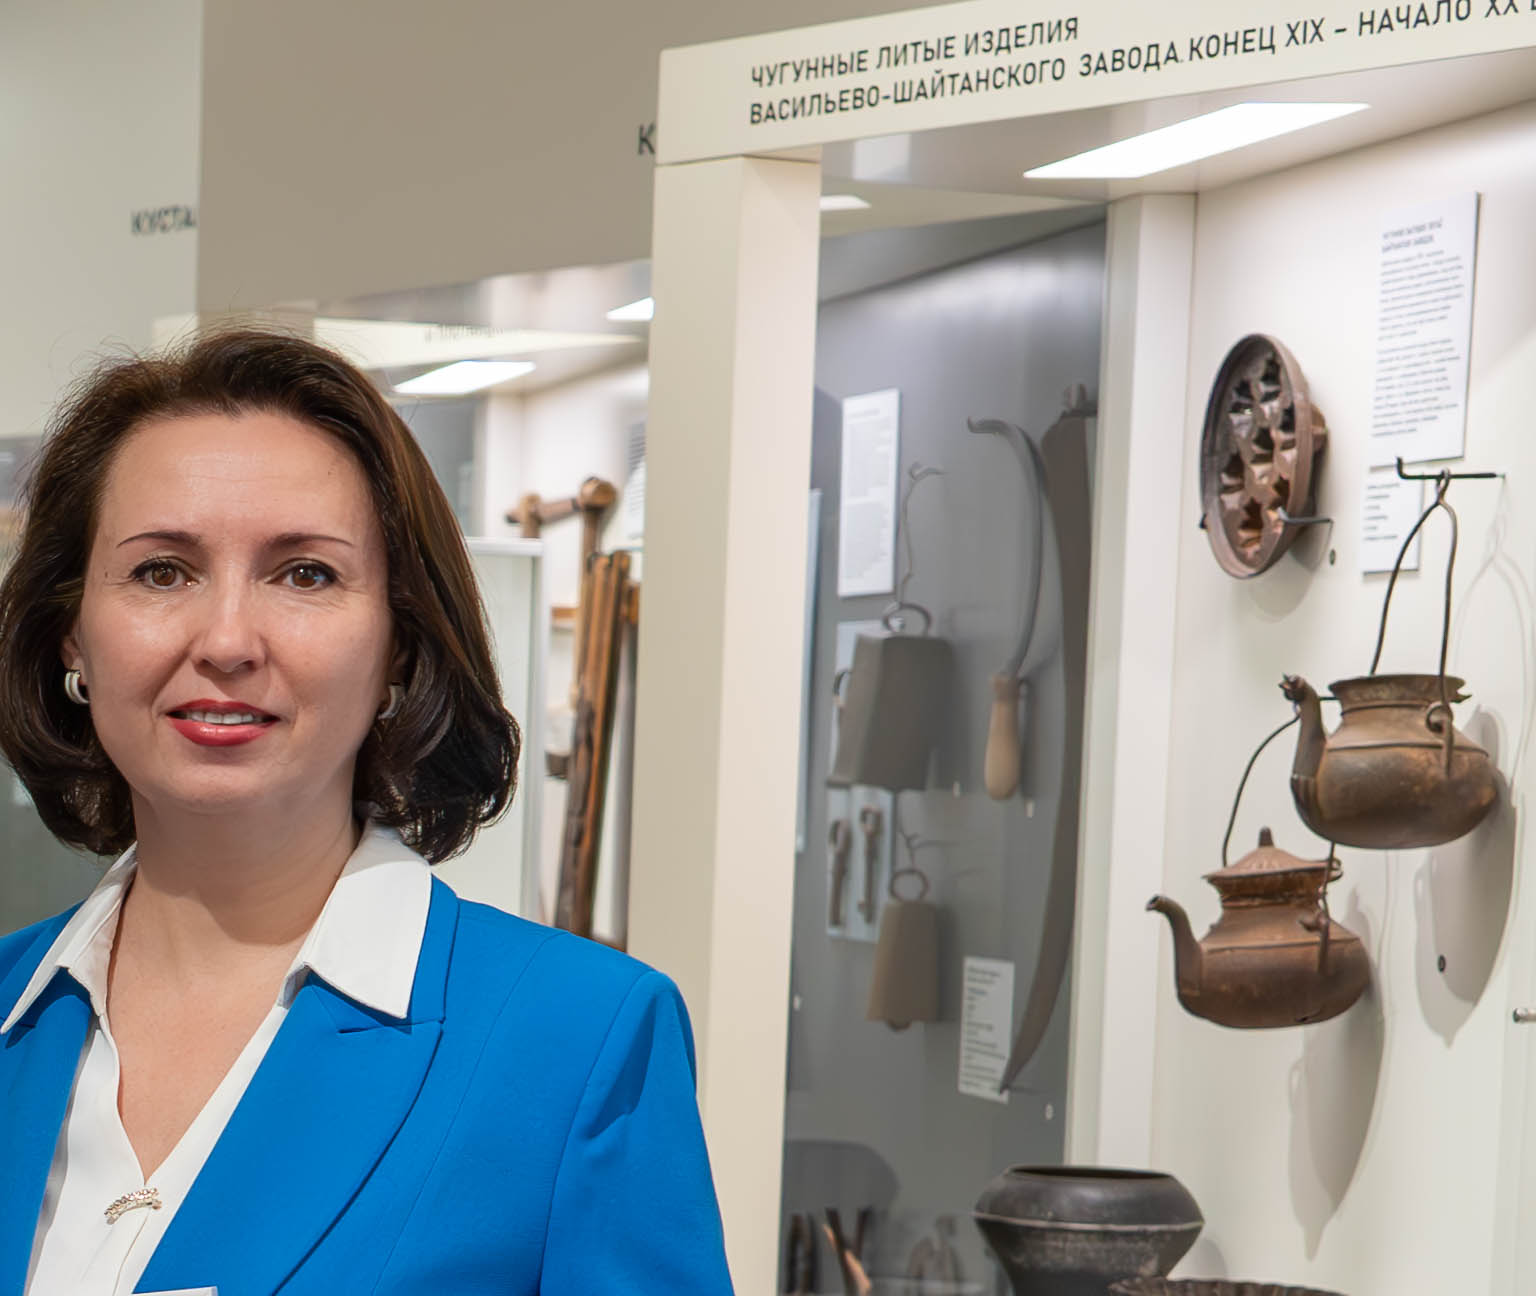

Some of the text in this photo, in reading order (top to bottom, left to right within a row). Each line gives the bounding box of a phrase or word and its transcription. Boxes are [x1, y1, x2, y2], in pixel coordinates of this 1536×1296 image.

[750, 58, 1065, 125] ВАСИЛЬЕВО-ШАЙТАНСКОГО
[1189, 26, 1275, 61] КОНЕЦ
[1359, 0, 1471, 36] НАЧАЛО
[752, 17, 1078, 87] ЧУГУННЫЕ ЛИТЫЕ ИЗДЕЛИЯ
